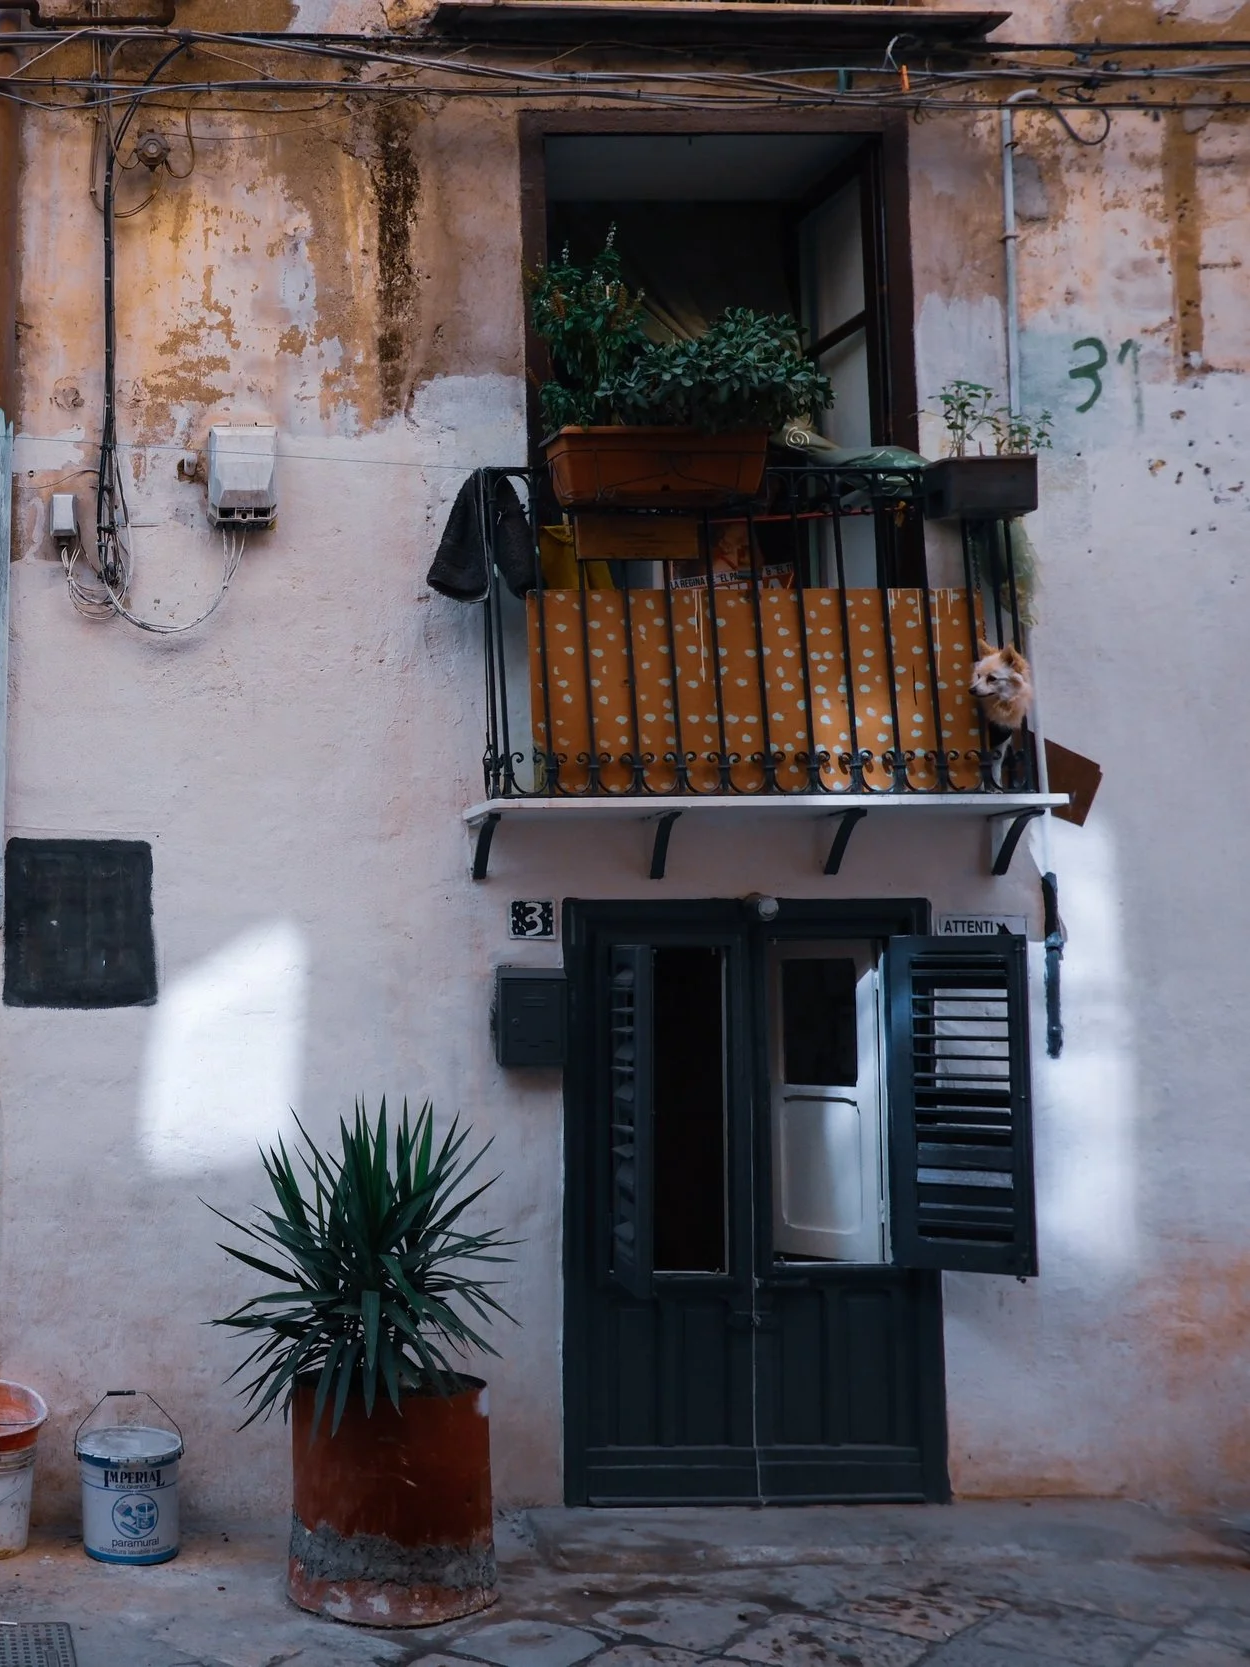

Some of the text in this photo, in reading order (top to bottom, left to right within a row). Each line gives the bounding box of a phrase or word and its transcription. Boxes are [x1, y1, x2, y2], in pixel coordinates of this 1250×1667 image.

[680, 576, 706, 588] REGINA
[525, 902, 543, 936] 3
[944, 919, 994, 934] ATTENTI
[103, 1469, 165, 1487] IMPERIAL
[111, 1536, 159, 1548] paramural
